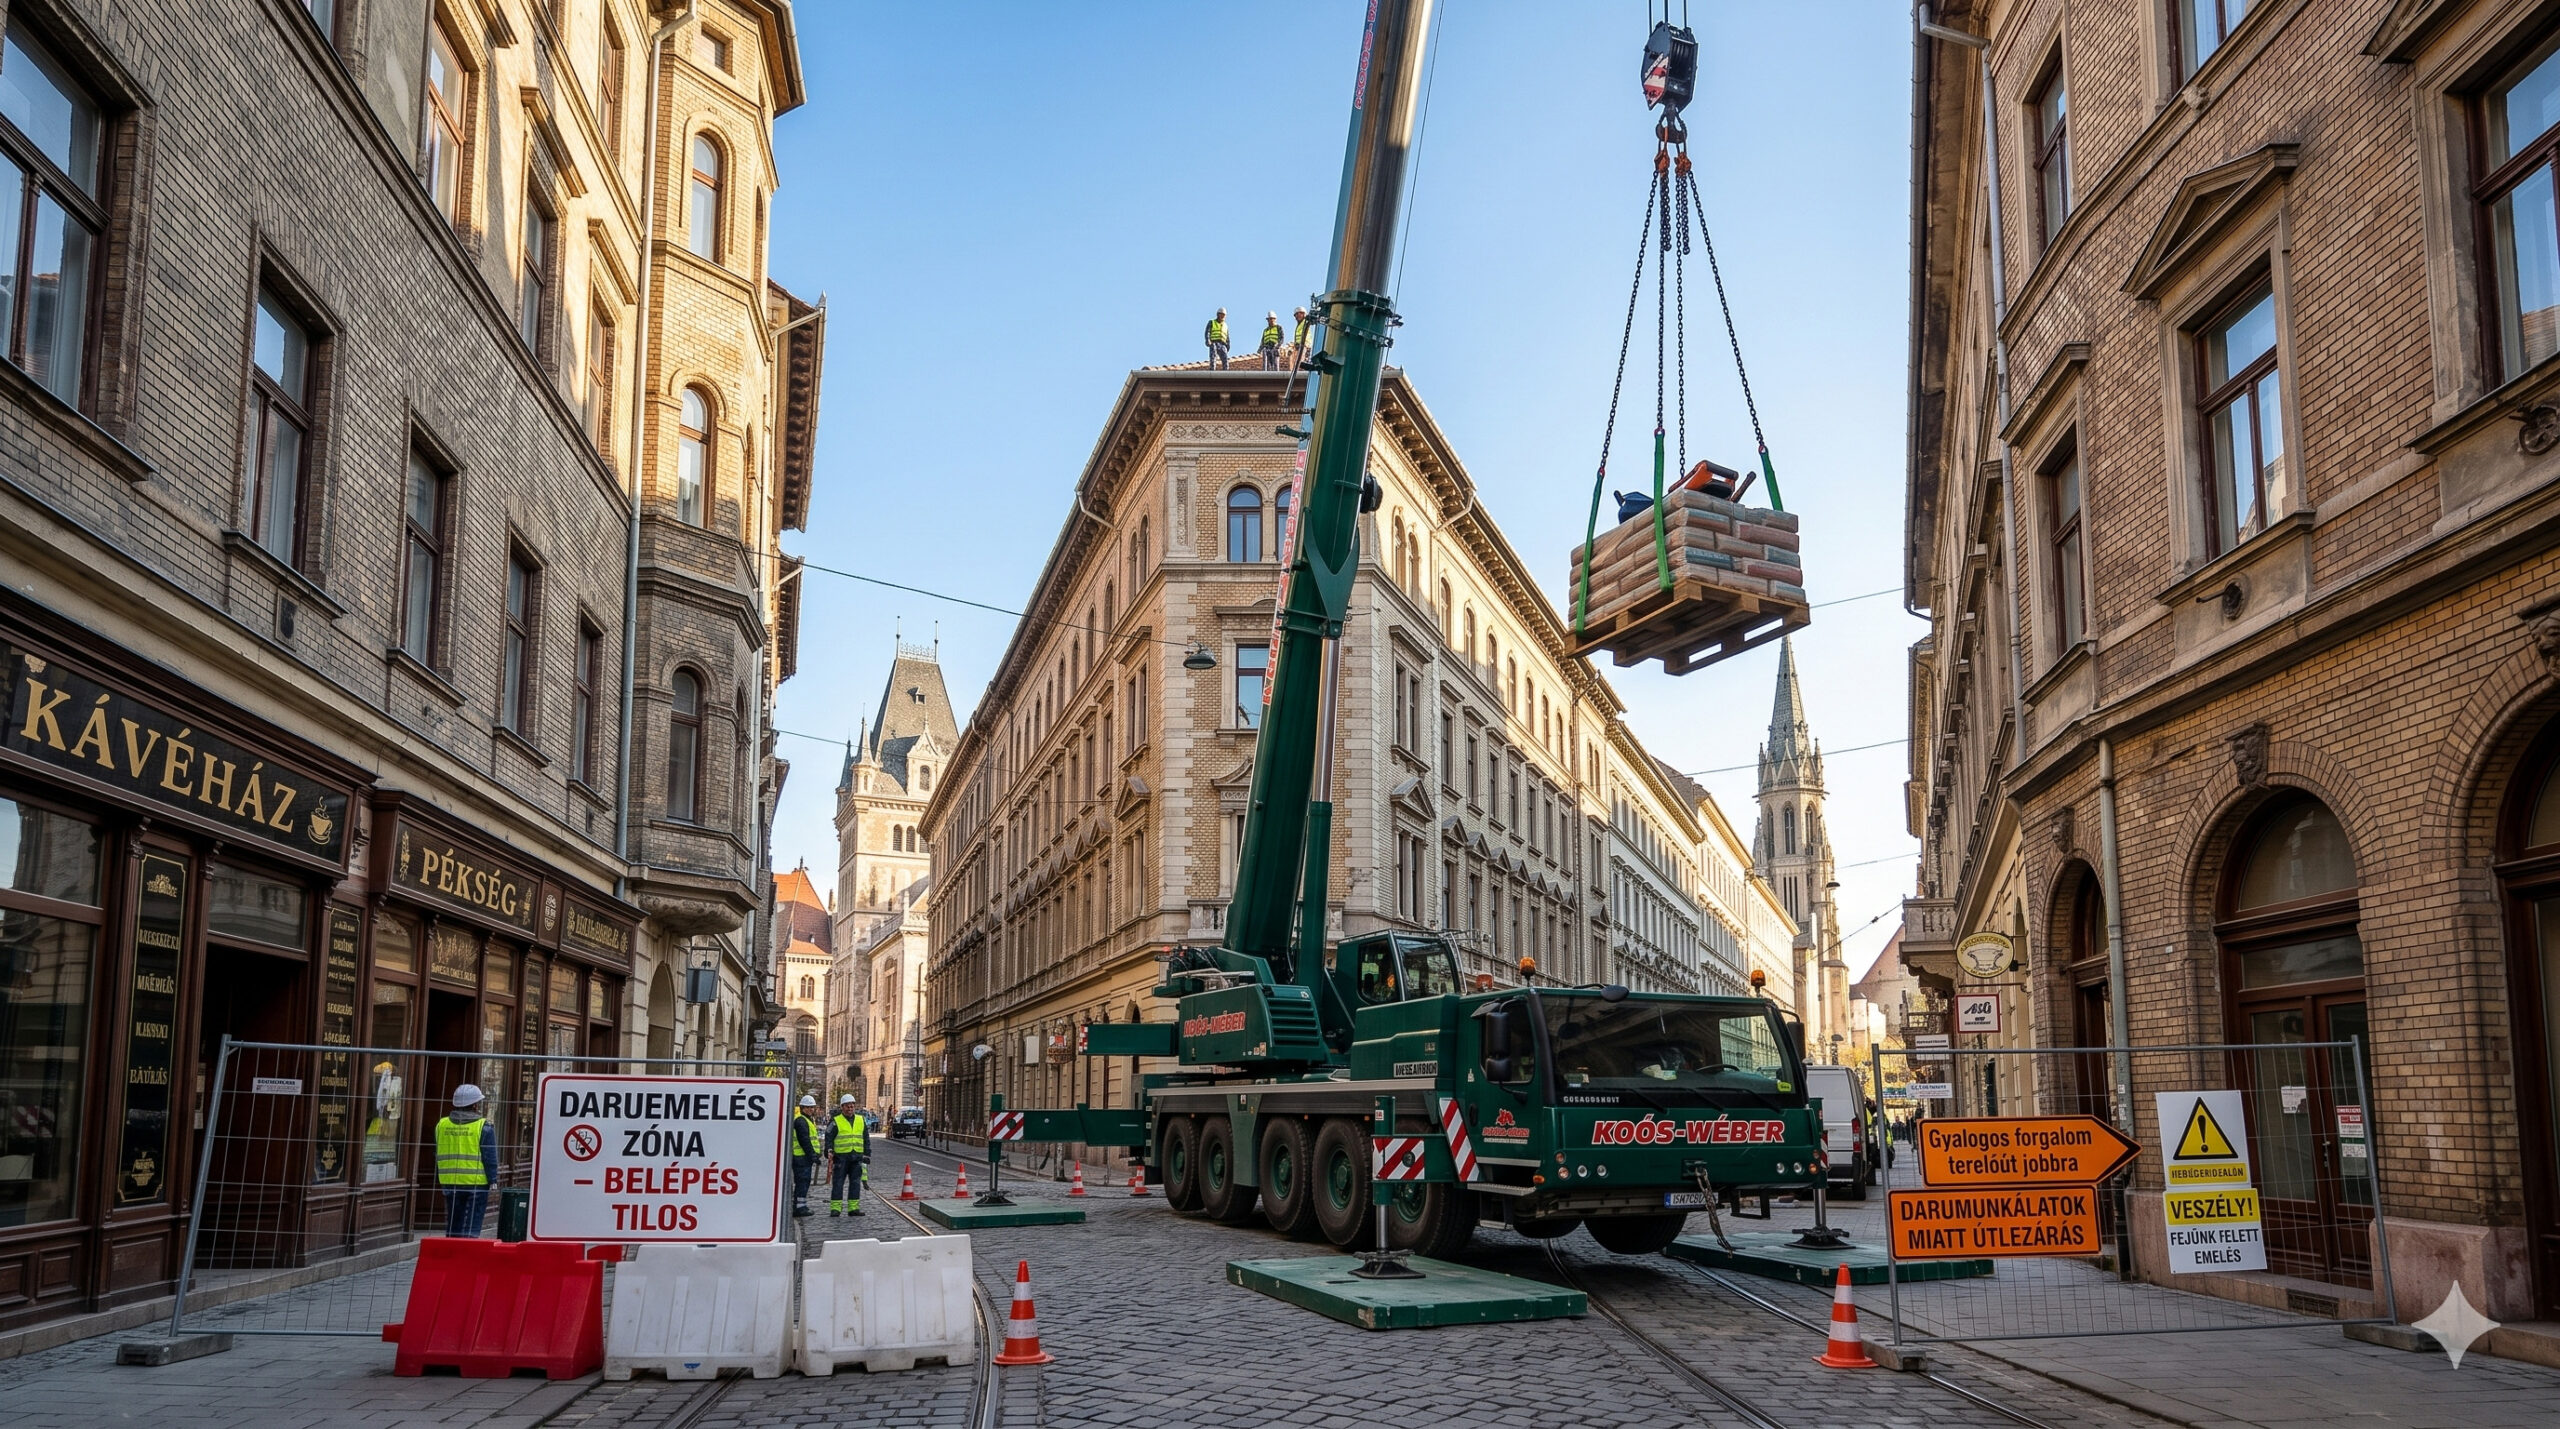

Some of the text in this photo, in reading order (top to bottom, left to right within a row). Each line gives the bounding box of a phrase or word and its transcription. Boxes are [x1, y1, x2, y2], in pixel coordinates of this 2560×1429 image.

[20, 677, 297, 833] KÁVÉHÁZ
[419, 848, 517, 917] PÉKSÉG
[559, 1088, 766, 1121] DARUEMELÉS
[622, 1124, 705, 1157] ZÓNA
[1929, 1127, 2092, 1152] Gyalogos forgalom
[604, 1161, 739, 1195] BELÉPÉS
[2023, 1153, 2079, 1177] jobbra
[612, 1204, 698, 1231] TILOS
[1901, 1193, 2087, 1221] DARUMUNKÁLATOK
[2170, 1193, 2253, 1219] VESZÉLY!
[1908, 1220, 2085, 1249] MIATT ÚTLEZÁRÁS
[2219, 1228, 2259, 1243] FELETT
[2195, 1246, 2242, 1264] EMELÉS
